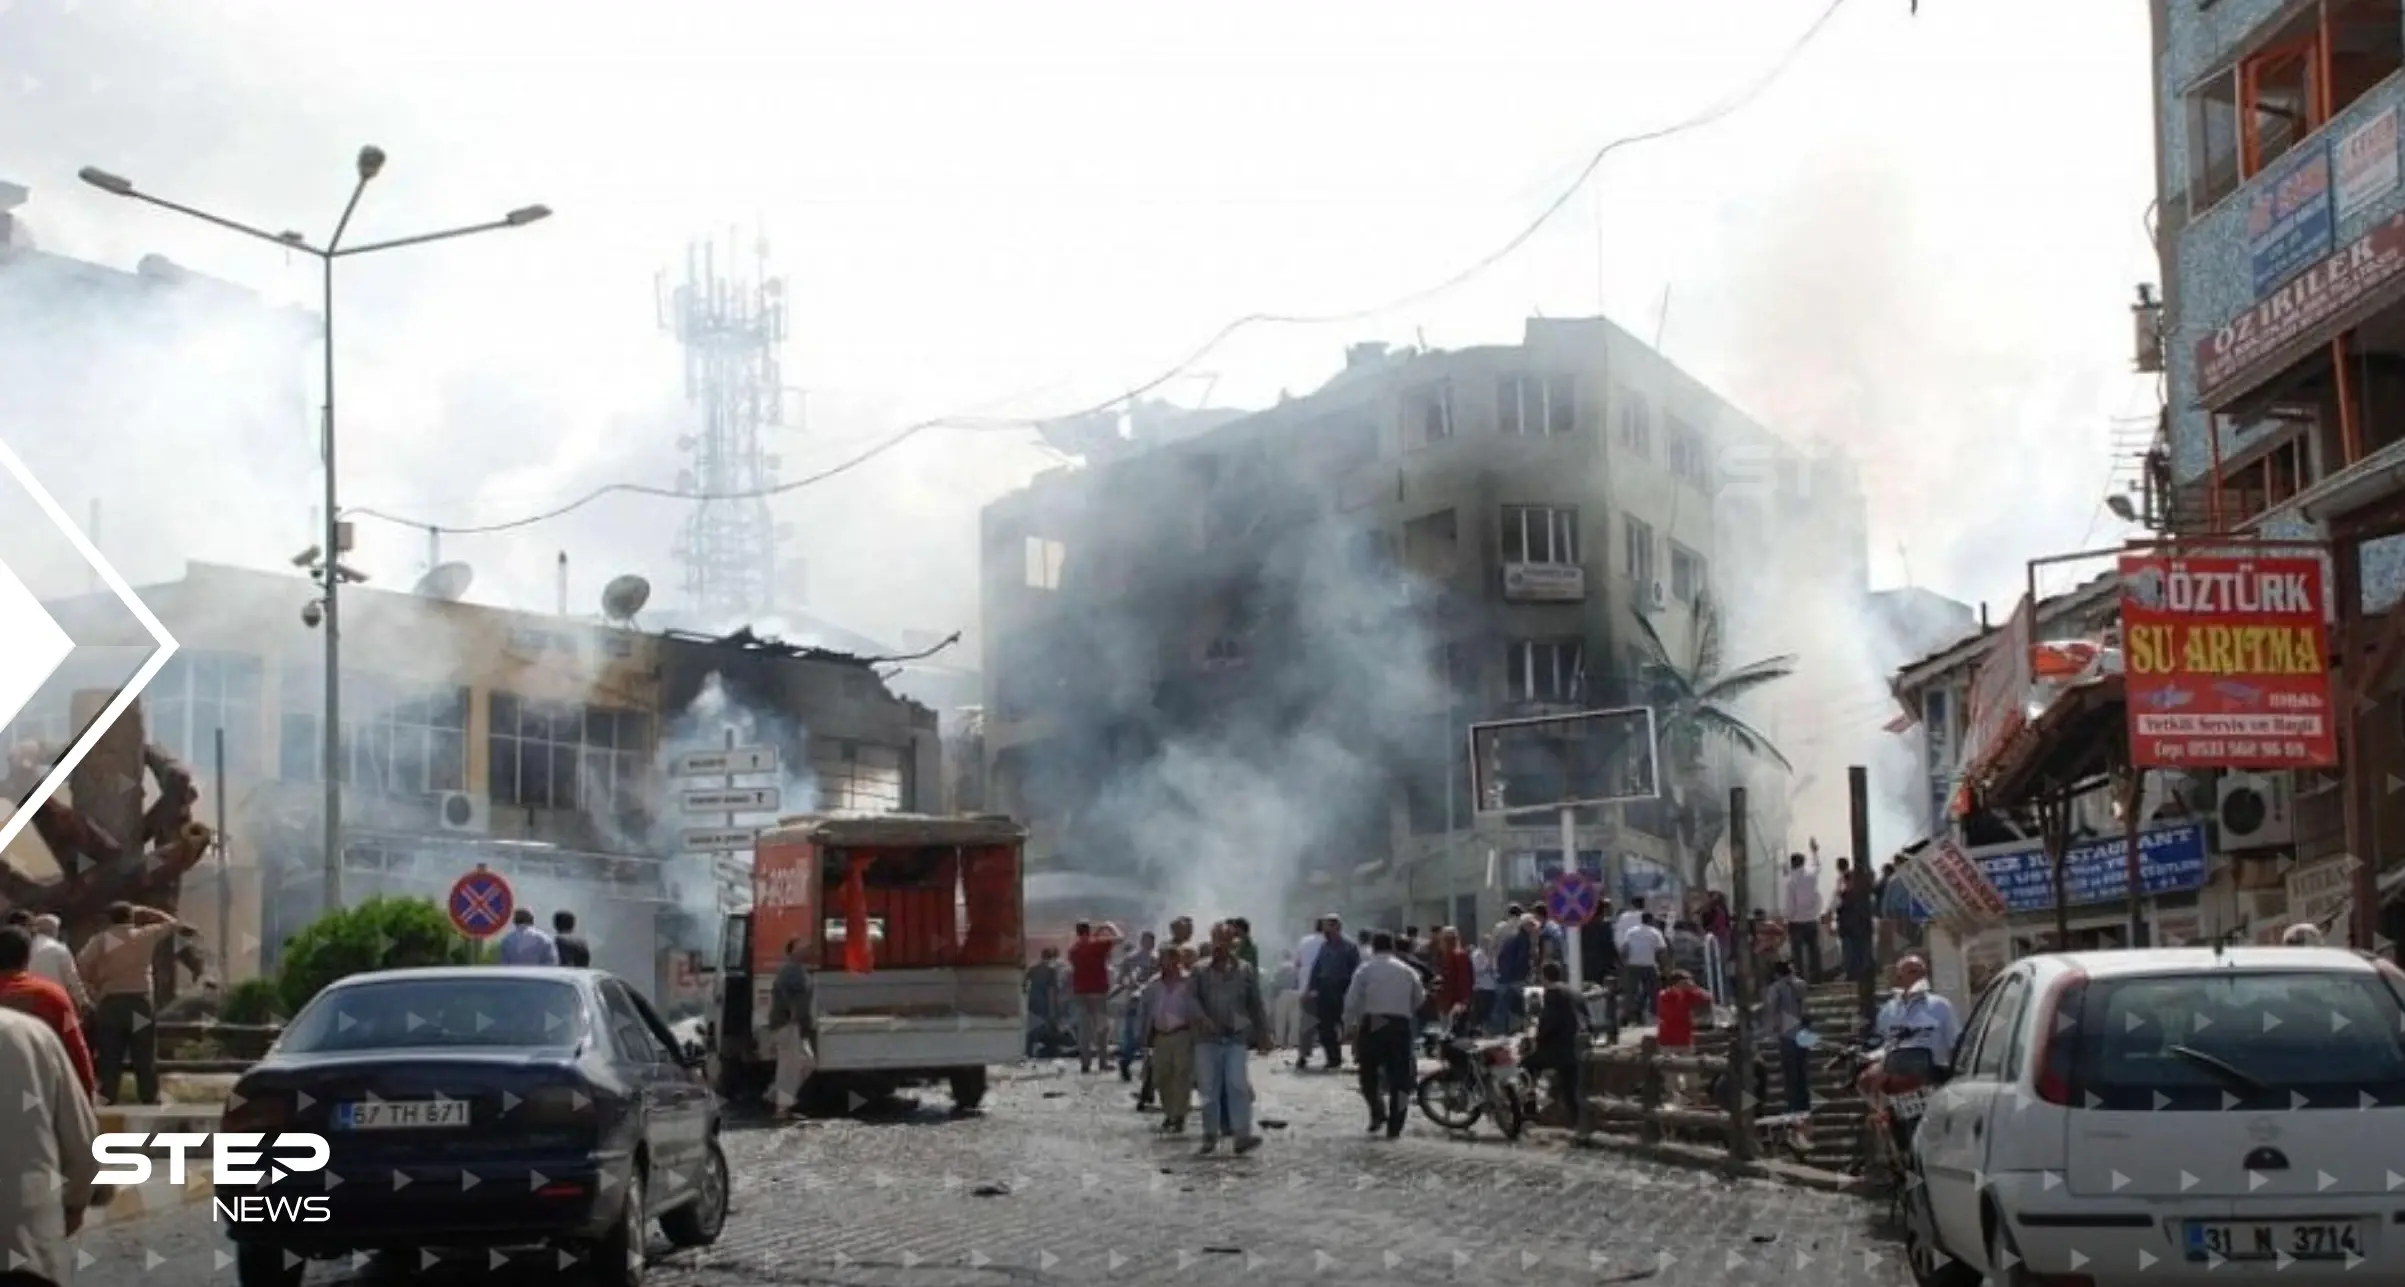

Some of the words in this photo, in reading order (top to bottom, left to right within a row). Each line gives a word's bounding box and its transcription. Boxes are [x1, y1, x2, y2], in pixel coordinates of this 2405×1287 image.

[2167, 562, 2314, 613] ÖZTÜRK
[2129, 623, 2177, 675] SU
[2182, 624, 2323, 675] ARITMA
[2198, 717, 2246, 732] Servis
[387, 1103, 419, 1124] TH
[2204, 1227, 2233, 1253] 31
